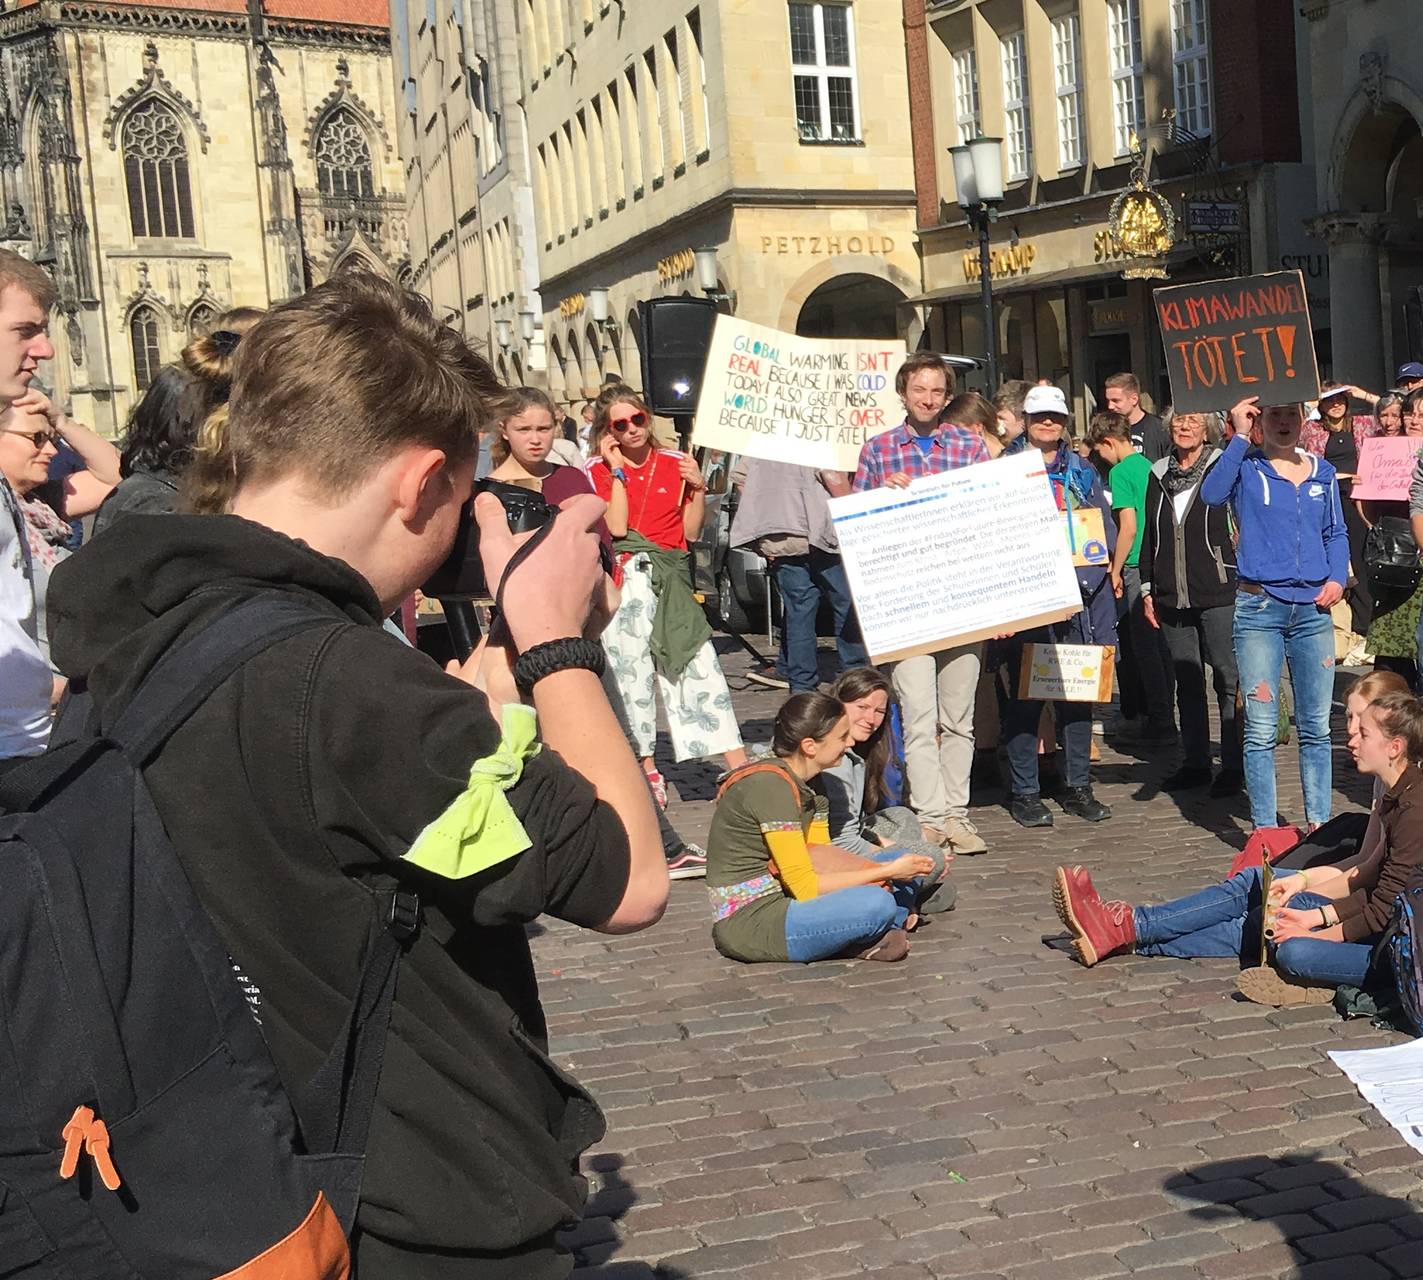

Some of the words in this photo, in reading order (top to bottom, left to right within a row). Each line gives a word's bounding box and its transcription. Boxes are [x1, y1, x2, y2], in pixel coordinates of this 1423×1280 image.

[761, 236, 896, 254] PETZHOLD
[1161, 284, 1306, 331] KLIMAWANDEL
[733, 335, 781, 364] GLOBAL
[789, 352, 849, 371] WARMING
[1172, 326, 1296, 390] TÖTET!
[728, 353, 761, 377] REAL
[768, 366, 821, 389] BECAUSE
[826, 375, 830, 390] I
[834, 375, 855, 390] WAS
[856, 375, 887, 391] COLD
[724, 392, 768, 414] WORLD
[773, 402, 828, 426] HUNGER
[835, 410, 845, 426] IS
[850, 409, 886, 427] OVER
[774, 386, 803, 403] ALSO
[808, 391, 842, 407] GREAT
[845, 392, 877, 408] NEWS
[718, 408, 781, 435] BECAUSE
[785, 422, 790, 436] I
[795, 422, 834, 442] JUST
[884, 599, 930, 617] schnellem
[950, 579, 1017, 602] konsequentem
[1018, 569, 1056, 584] Handeln
